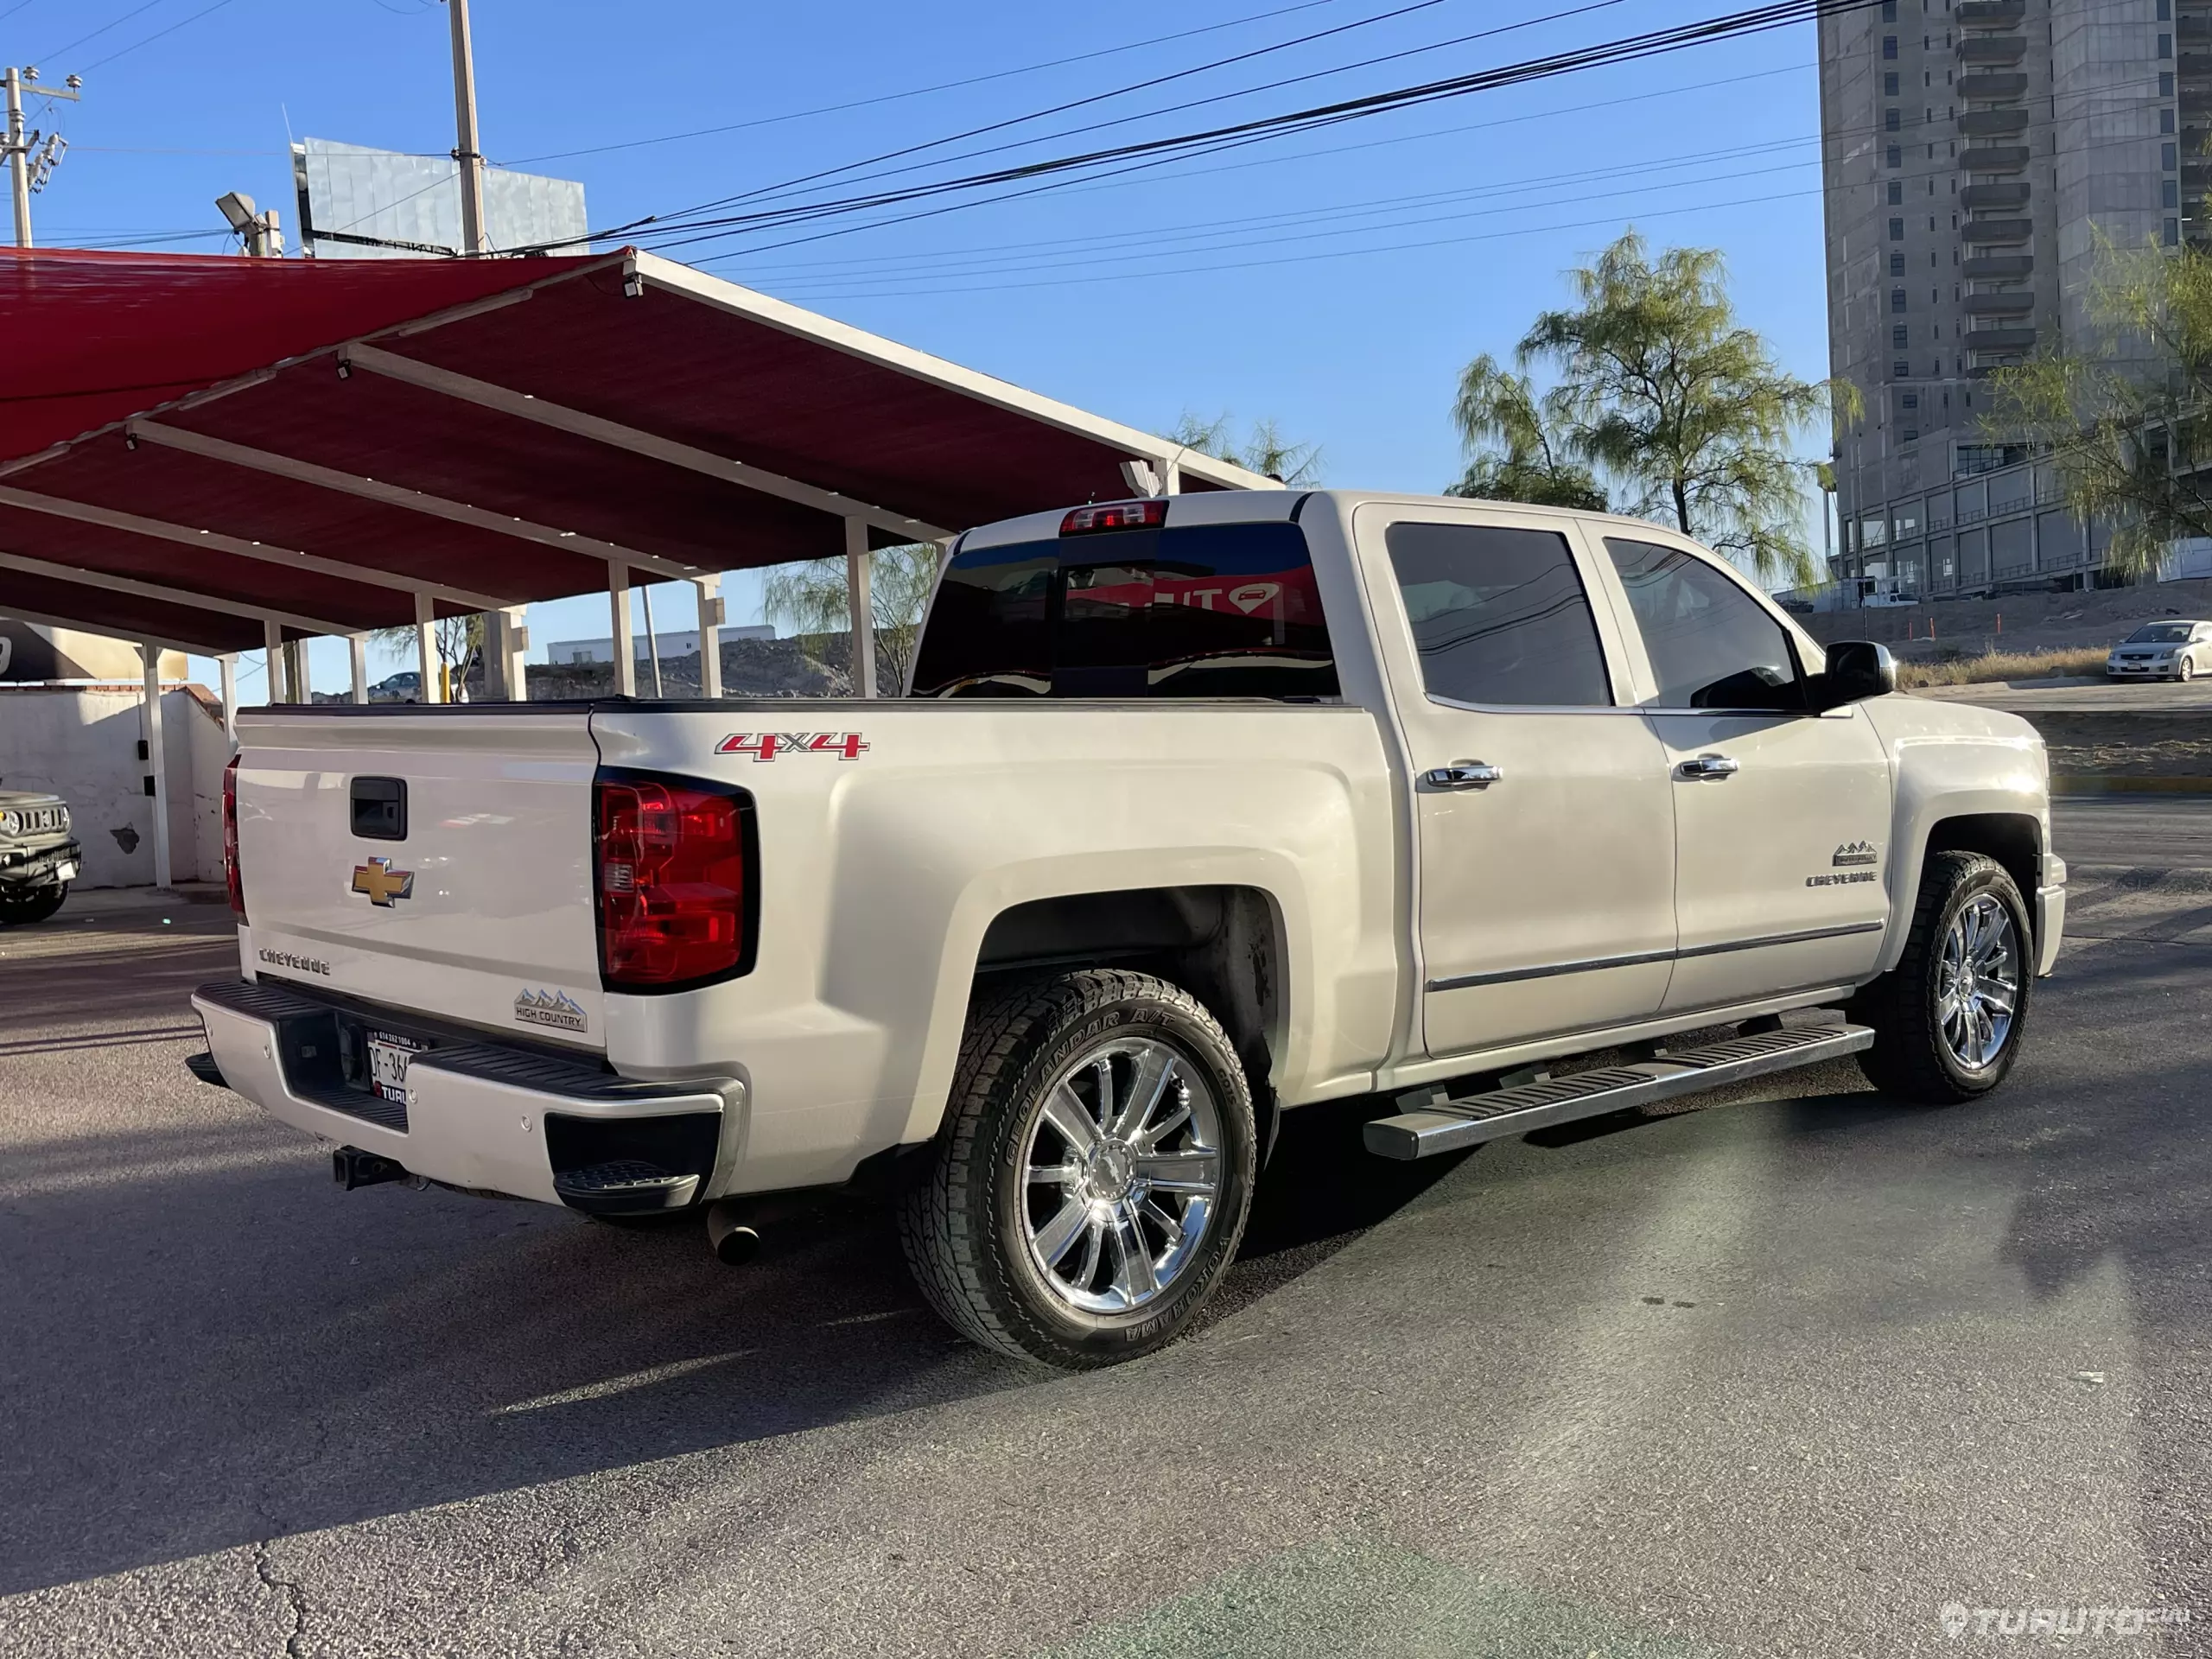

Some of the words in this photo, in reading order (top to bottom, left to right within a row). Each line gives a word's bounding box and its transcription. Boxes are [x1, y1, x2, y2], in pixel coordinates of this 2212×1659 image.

[1805, 871, 1877, 887] CHEYENNE
[258, 948, 330, 976] CHEYENNE
[516, 1007, 537, 1019] HIGH
[539, 1011, 582, 1027] COUNTRY
[1006, 1011, 1121, 1166] GEOLANDAR
[1130, 1007, 1177, 1027] A/T
[1126, 1236, 1231, 1342] YOKOHAMA
